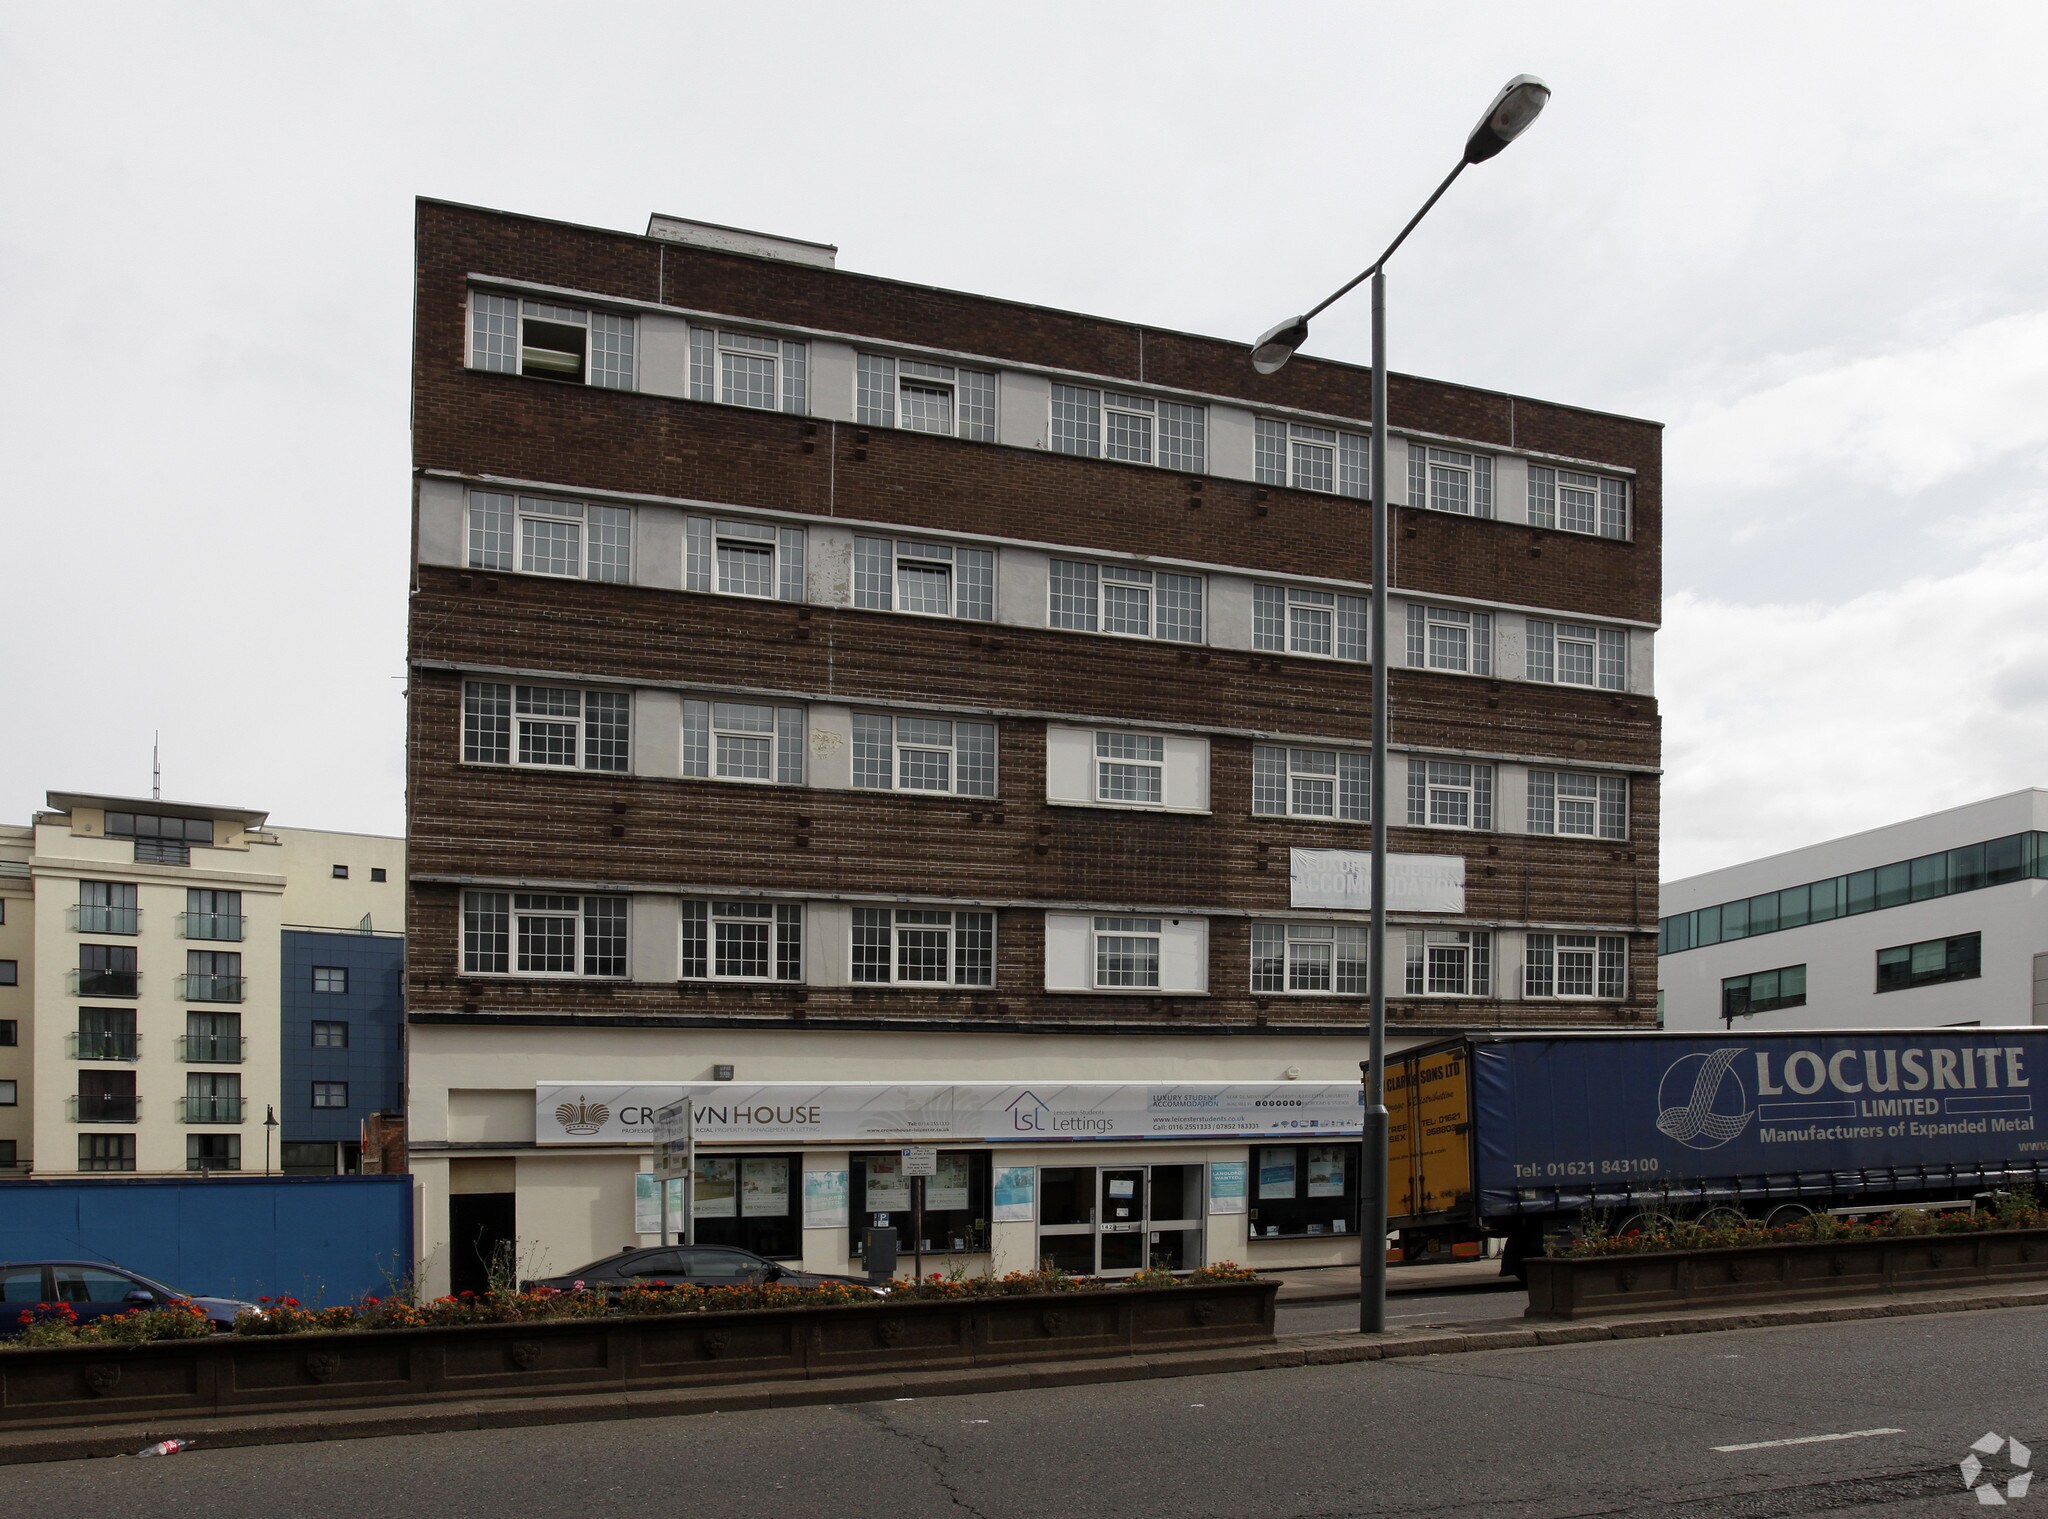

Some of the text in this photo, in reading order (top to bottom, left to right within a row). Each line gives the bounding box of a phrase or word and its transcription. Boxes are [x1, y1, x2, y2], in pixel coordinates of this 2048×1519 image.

[1420, 1065, 1443, 1084] SONS
[1446, 1061, 1460, 1078] LTD
[1755, 1047, 2029, 1095] LOCUSRITE
[734, 1106, 821, 1124] HOUSE
[1439, 1112, 1461, 1123] 01621
[1862, 1098, 1939, 1117] LIMITED
[1053, 1116, 1113, 1134] Lettings
[1759, 1116, 2034, 1143] Manufacturers of Expanded Metal
[1513, 1157, 1659, 1178] Tel: 01621 843100
